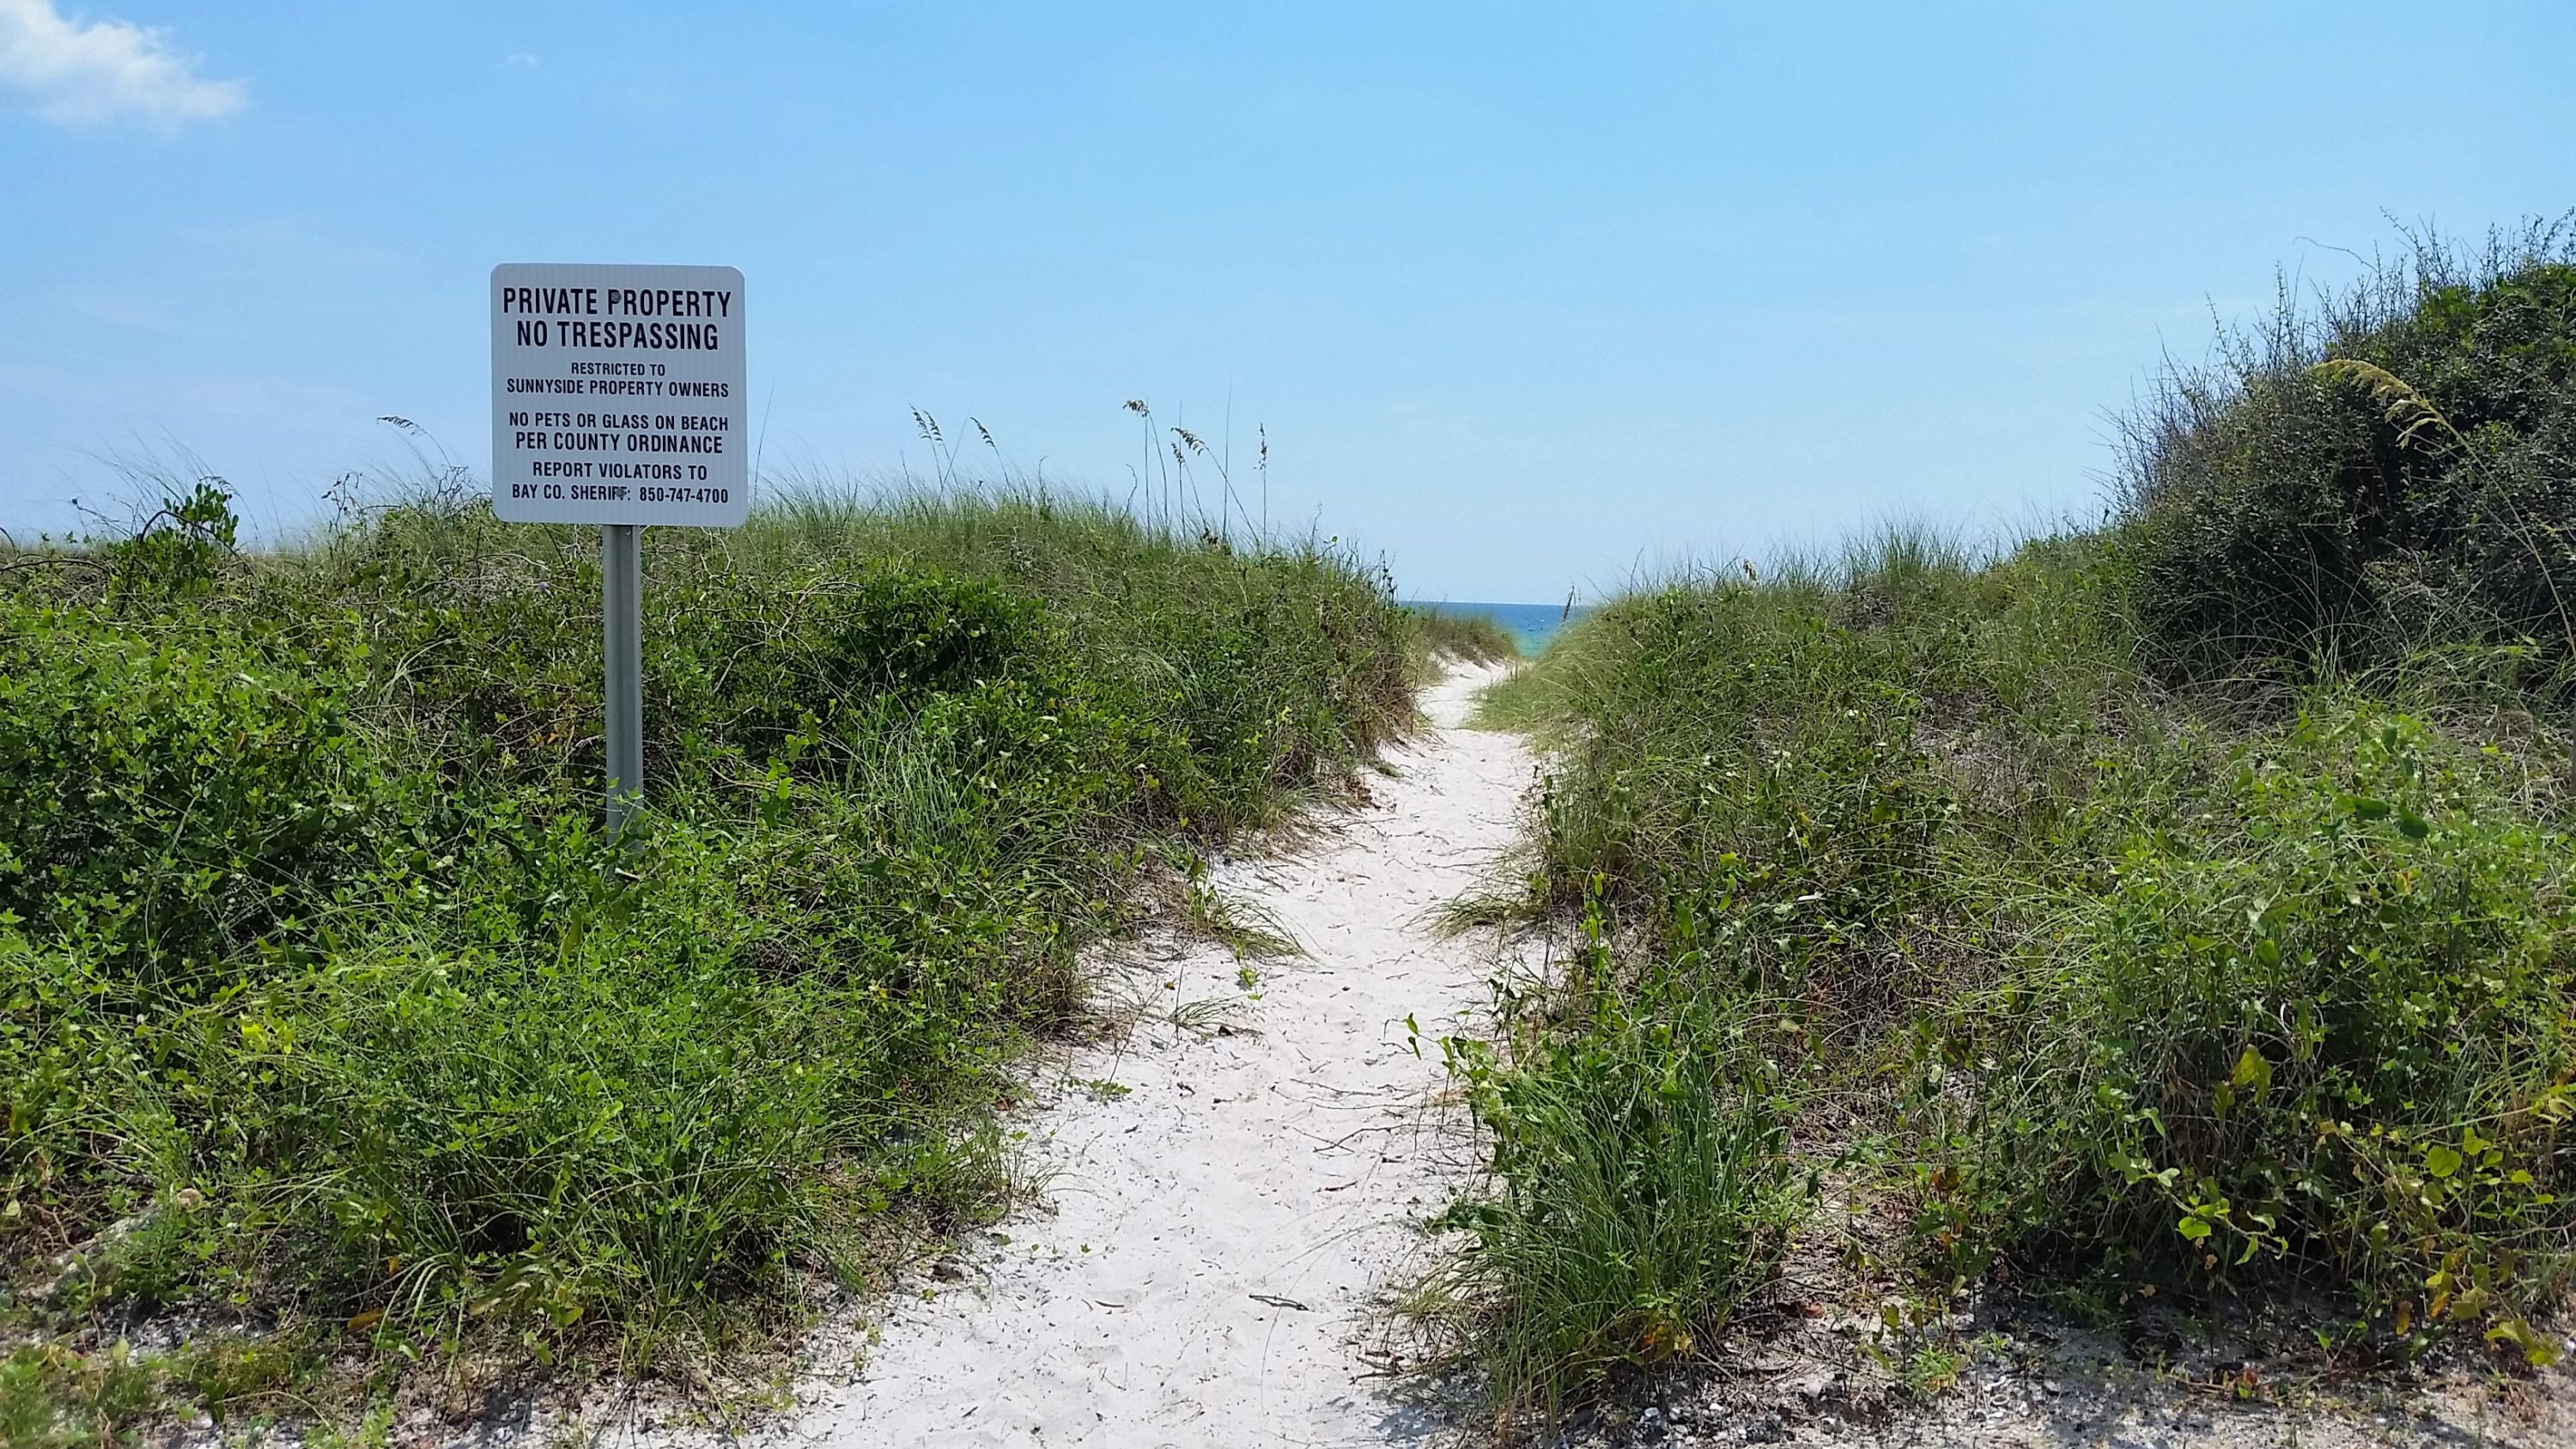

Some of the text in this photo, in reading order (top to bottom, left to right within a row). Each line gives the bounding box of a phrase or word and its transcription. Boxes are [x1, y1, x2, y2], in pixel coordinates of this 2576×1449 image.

[503, 287, 732, 318] PRIVATE PROPERTY
[517, 320, 719, 350] NO TRESPASSING
[571, 362, 666, 377] RESTRICTED TO
[507, 378, 729, 398] SUNNYSIDE PROPERTY OWNERS
[509, 411, 729, 432] NO PETS OR GLASS ON BEACH
[515, 431, 723, 454] PER COUNTY ORDINANCE
[532, 461, 708, 481] REPORT VIOLATORS TO
[512, 483, 538, 499] BAY
[544, 484, 566, 500] CO.
[639, 486, 729, 504] 850-747-4700
